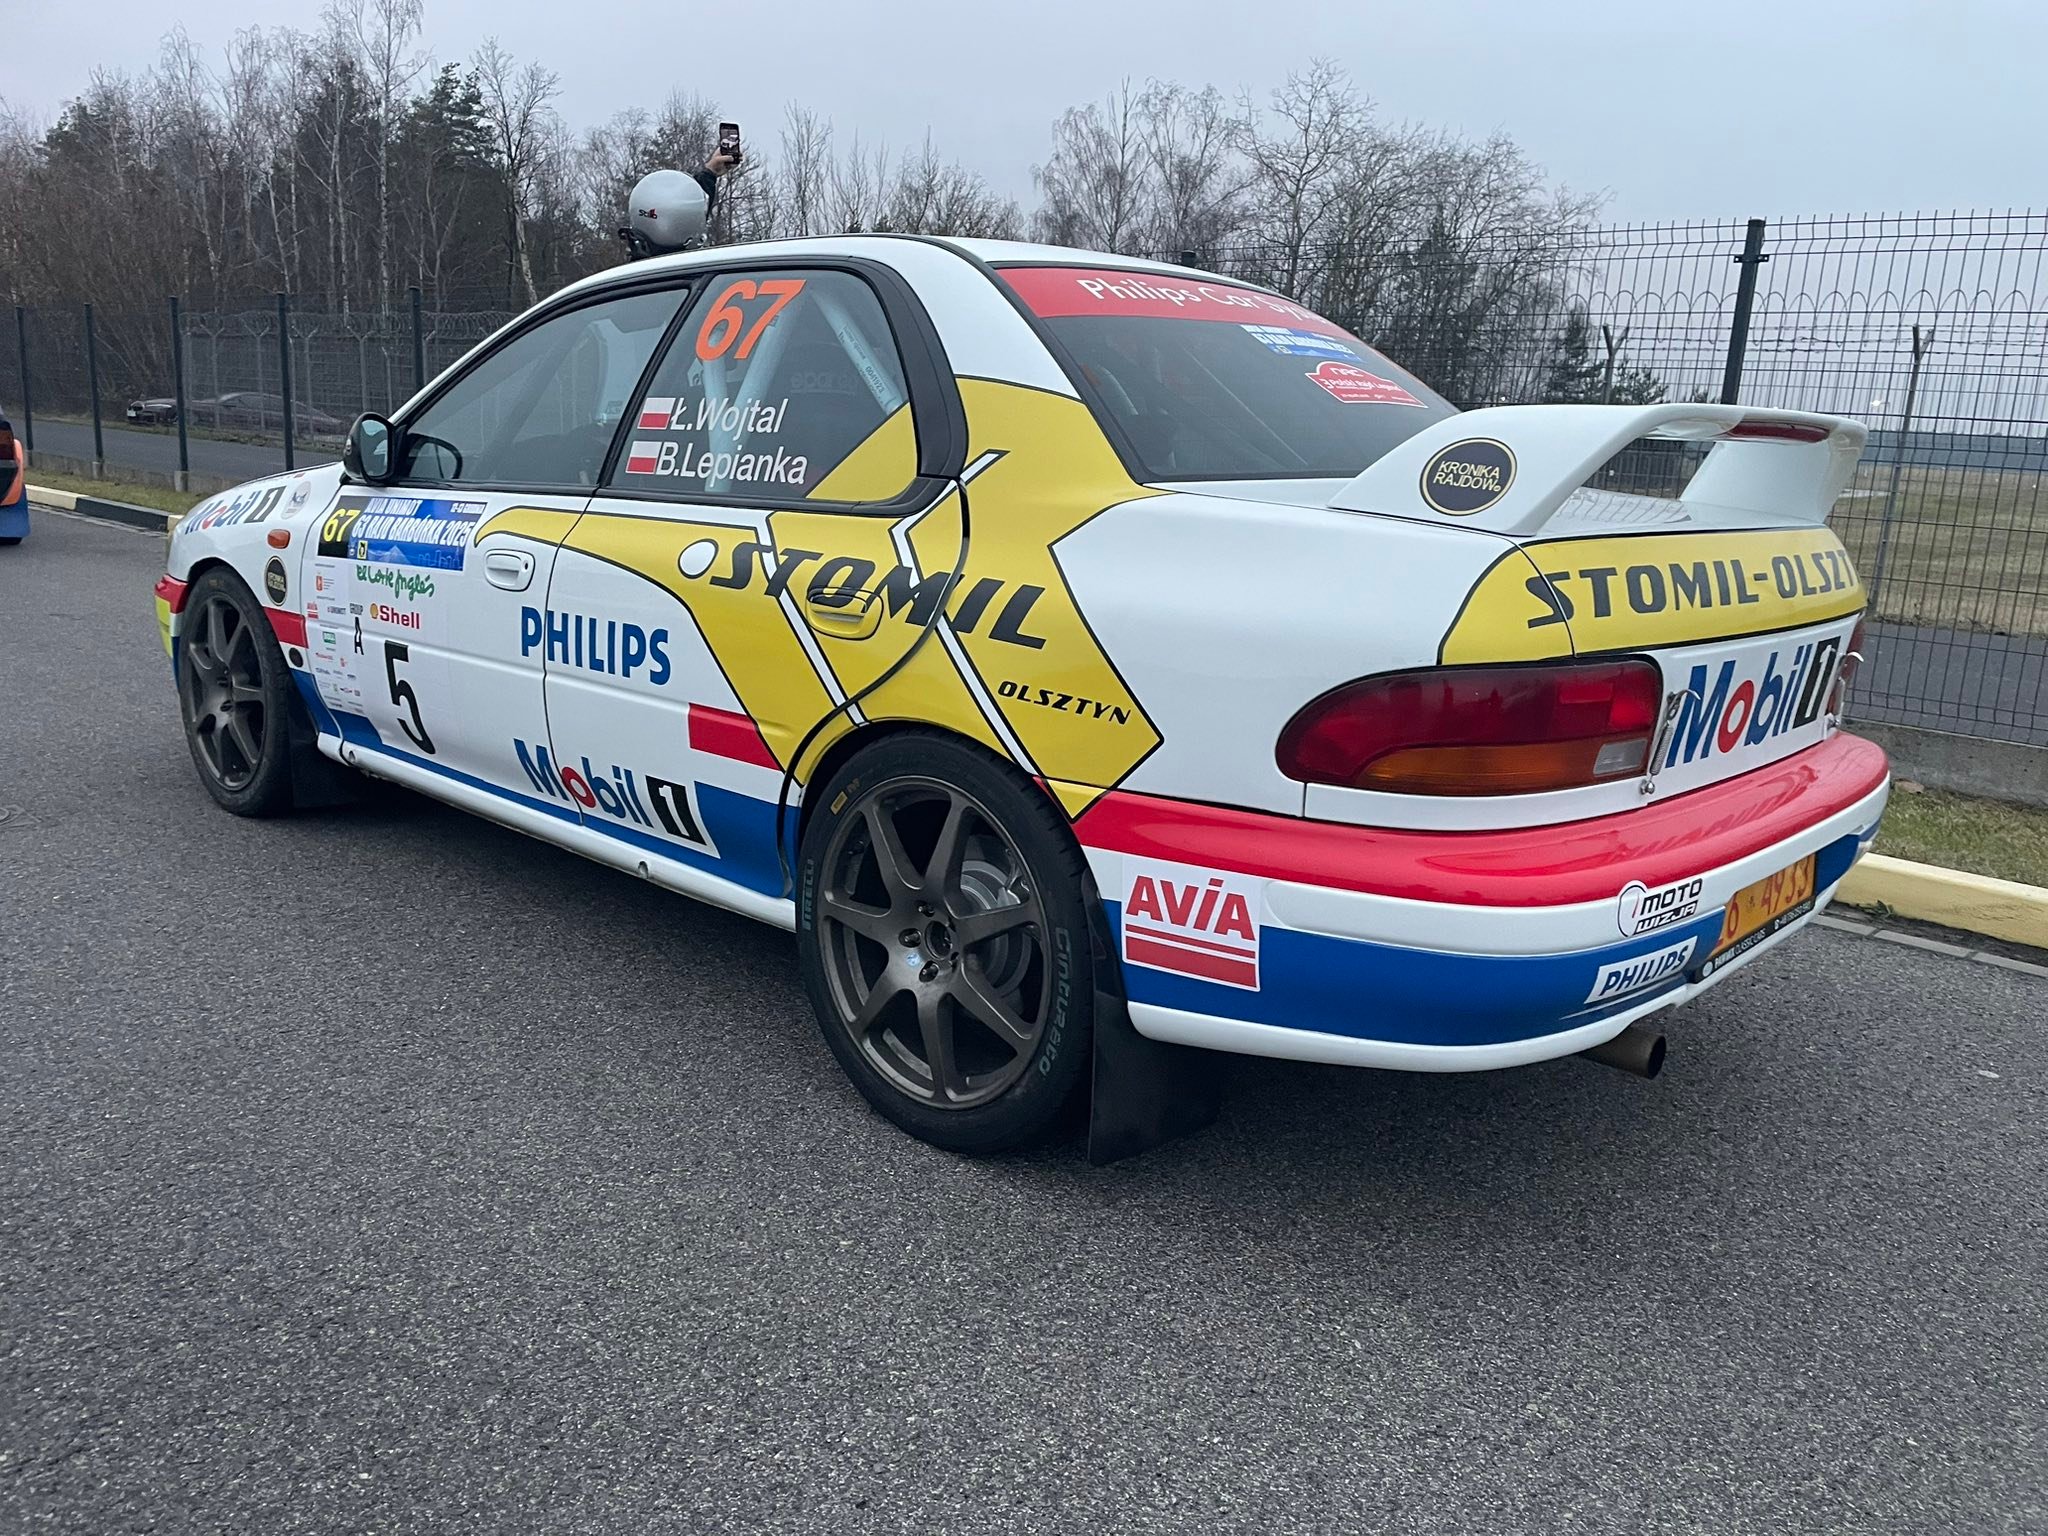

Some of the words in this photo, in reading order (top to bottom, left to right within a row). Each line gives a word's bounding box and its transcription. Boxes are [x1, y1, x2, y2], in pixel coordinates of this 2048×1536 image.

[1076, 278, 1201, 307] Philips
[1198, 287, 1260, 309] Car
[696, 279, 807, 363] 67
[670, 398, 789, 441] Ł.Wojtal
[656, 441, 808, 488] B.Lepianka
[1438, 461, 1500, 479] KRONIKA
[185, 490, 262, 535] Mobil
[247, 487, 283, 523] 1
[323, 508, 360, 543] 67
[351, 514, 368, 538] 63
[365, 515, 392, 540] RAJD
[388, 514, 444, 545] BARBÓRKA
[440, 520, 475, 547] 2025
[395, 569, 434, 601] Inglés
[709, 541, 1047, 650] STOMIL
[354, 616, 364, 655] A
[380, 605, 420, 629] Shell
[521, 605, 672, 686] PHILIPS
[384, 640, 436, 755] 5
[998, 681, 1131, 725] OLSZTYN
[1665, 643, 1815, 769] Mobil
[1797, 639, 1838, 724] 1
[513, 738, 654, 829] Mobil
[651, 779, 700, 843] 1
[1635, 902, 1697, 933] WIZJA
[1640, 878, 1703, 916] MOTO
[1599, 945, 1689, 997] PHILIPS
